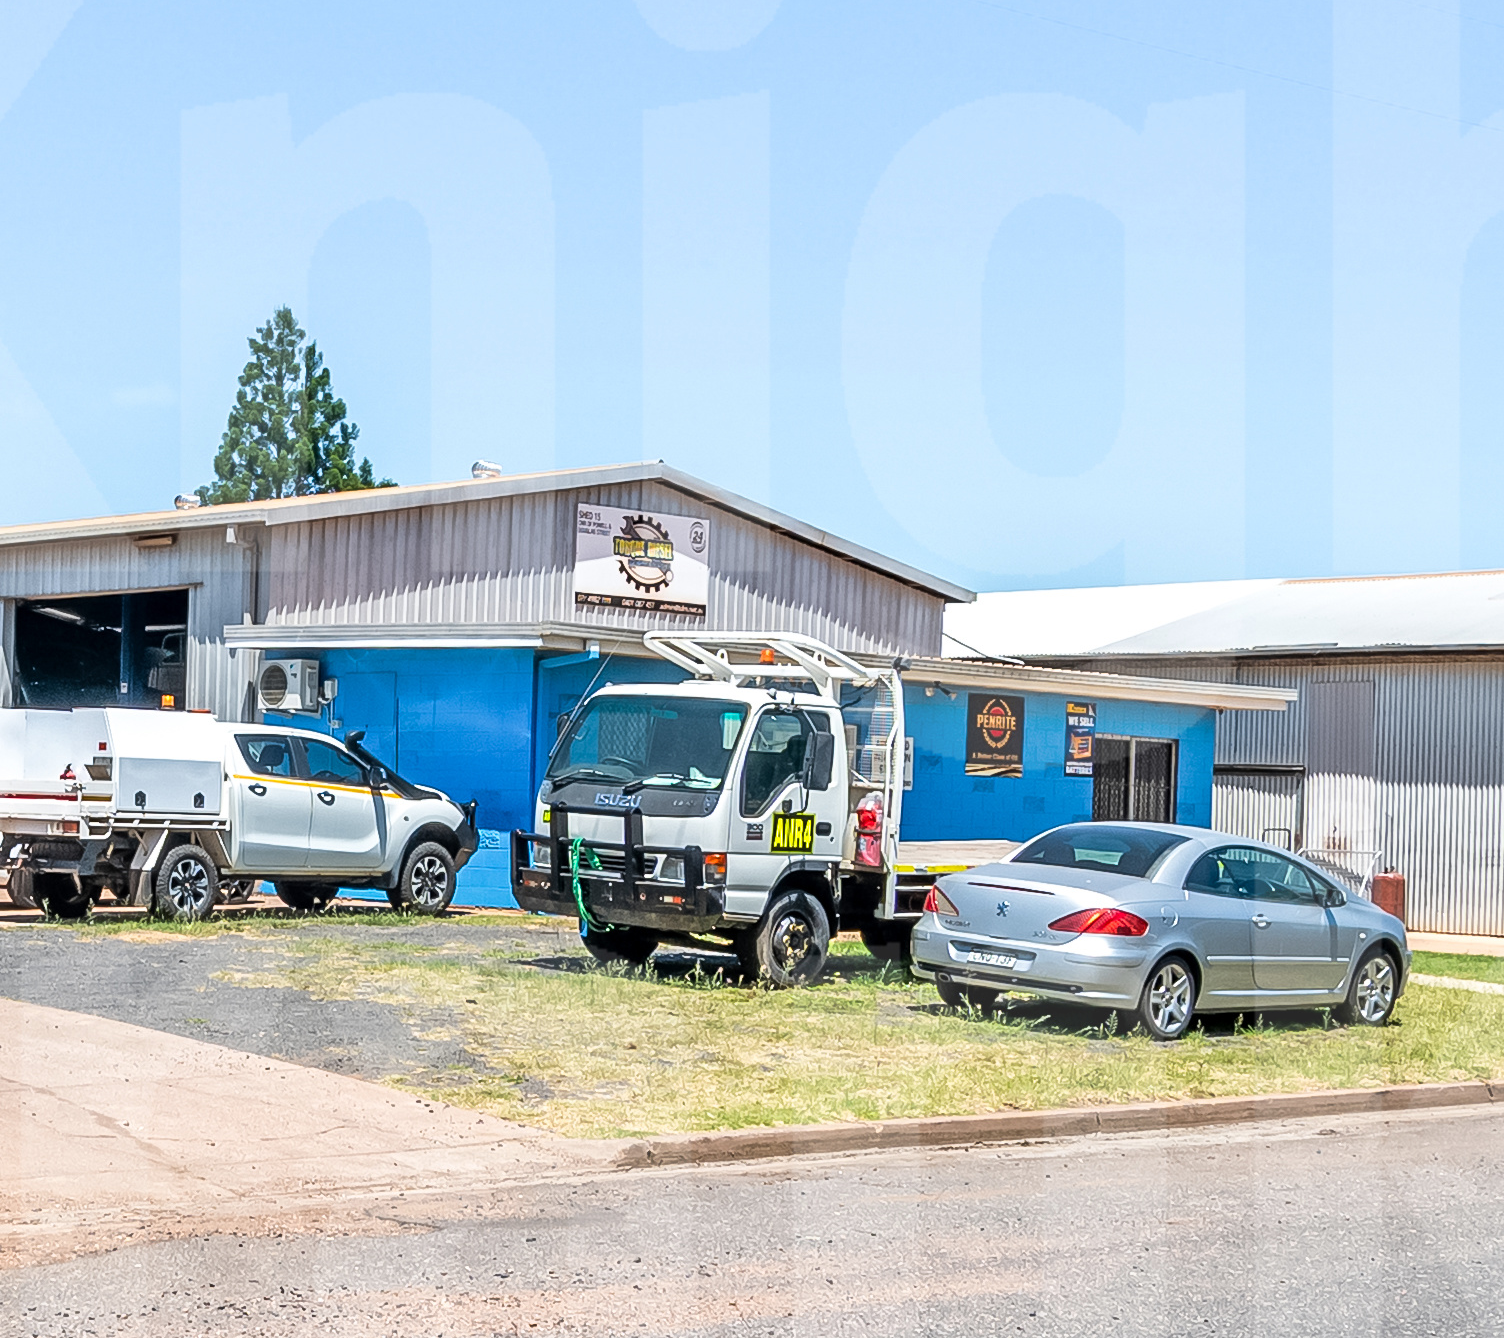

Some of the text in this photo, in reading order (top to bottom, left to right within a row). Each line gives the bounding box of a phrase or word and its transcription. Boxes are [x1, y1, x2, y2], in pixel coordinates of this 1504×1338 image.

[976, 714, 1017, 730] PENRITE
[594, 792, 642, 807] ISUZU
[773, 818, 812, 848] ANR4
